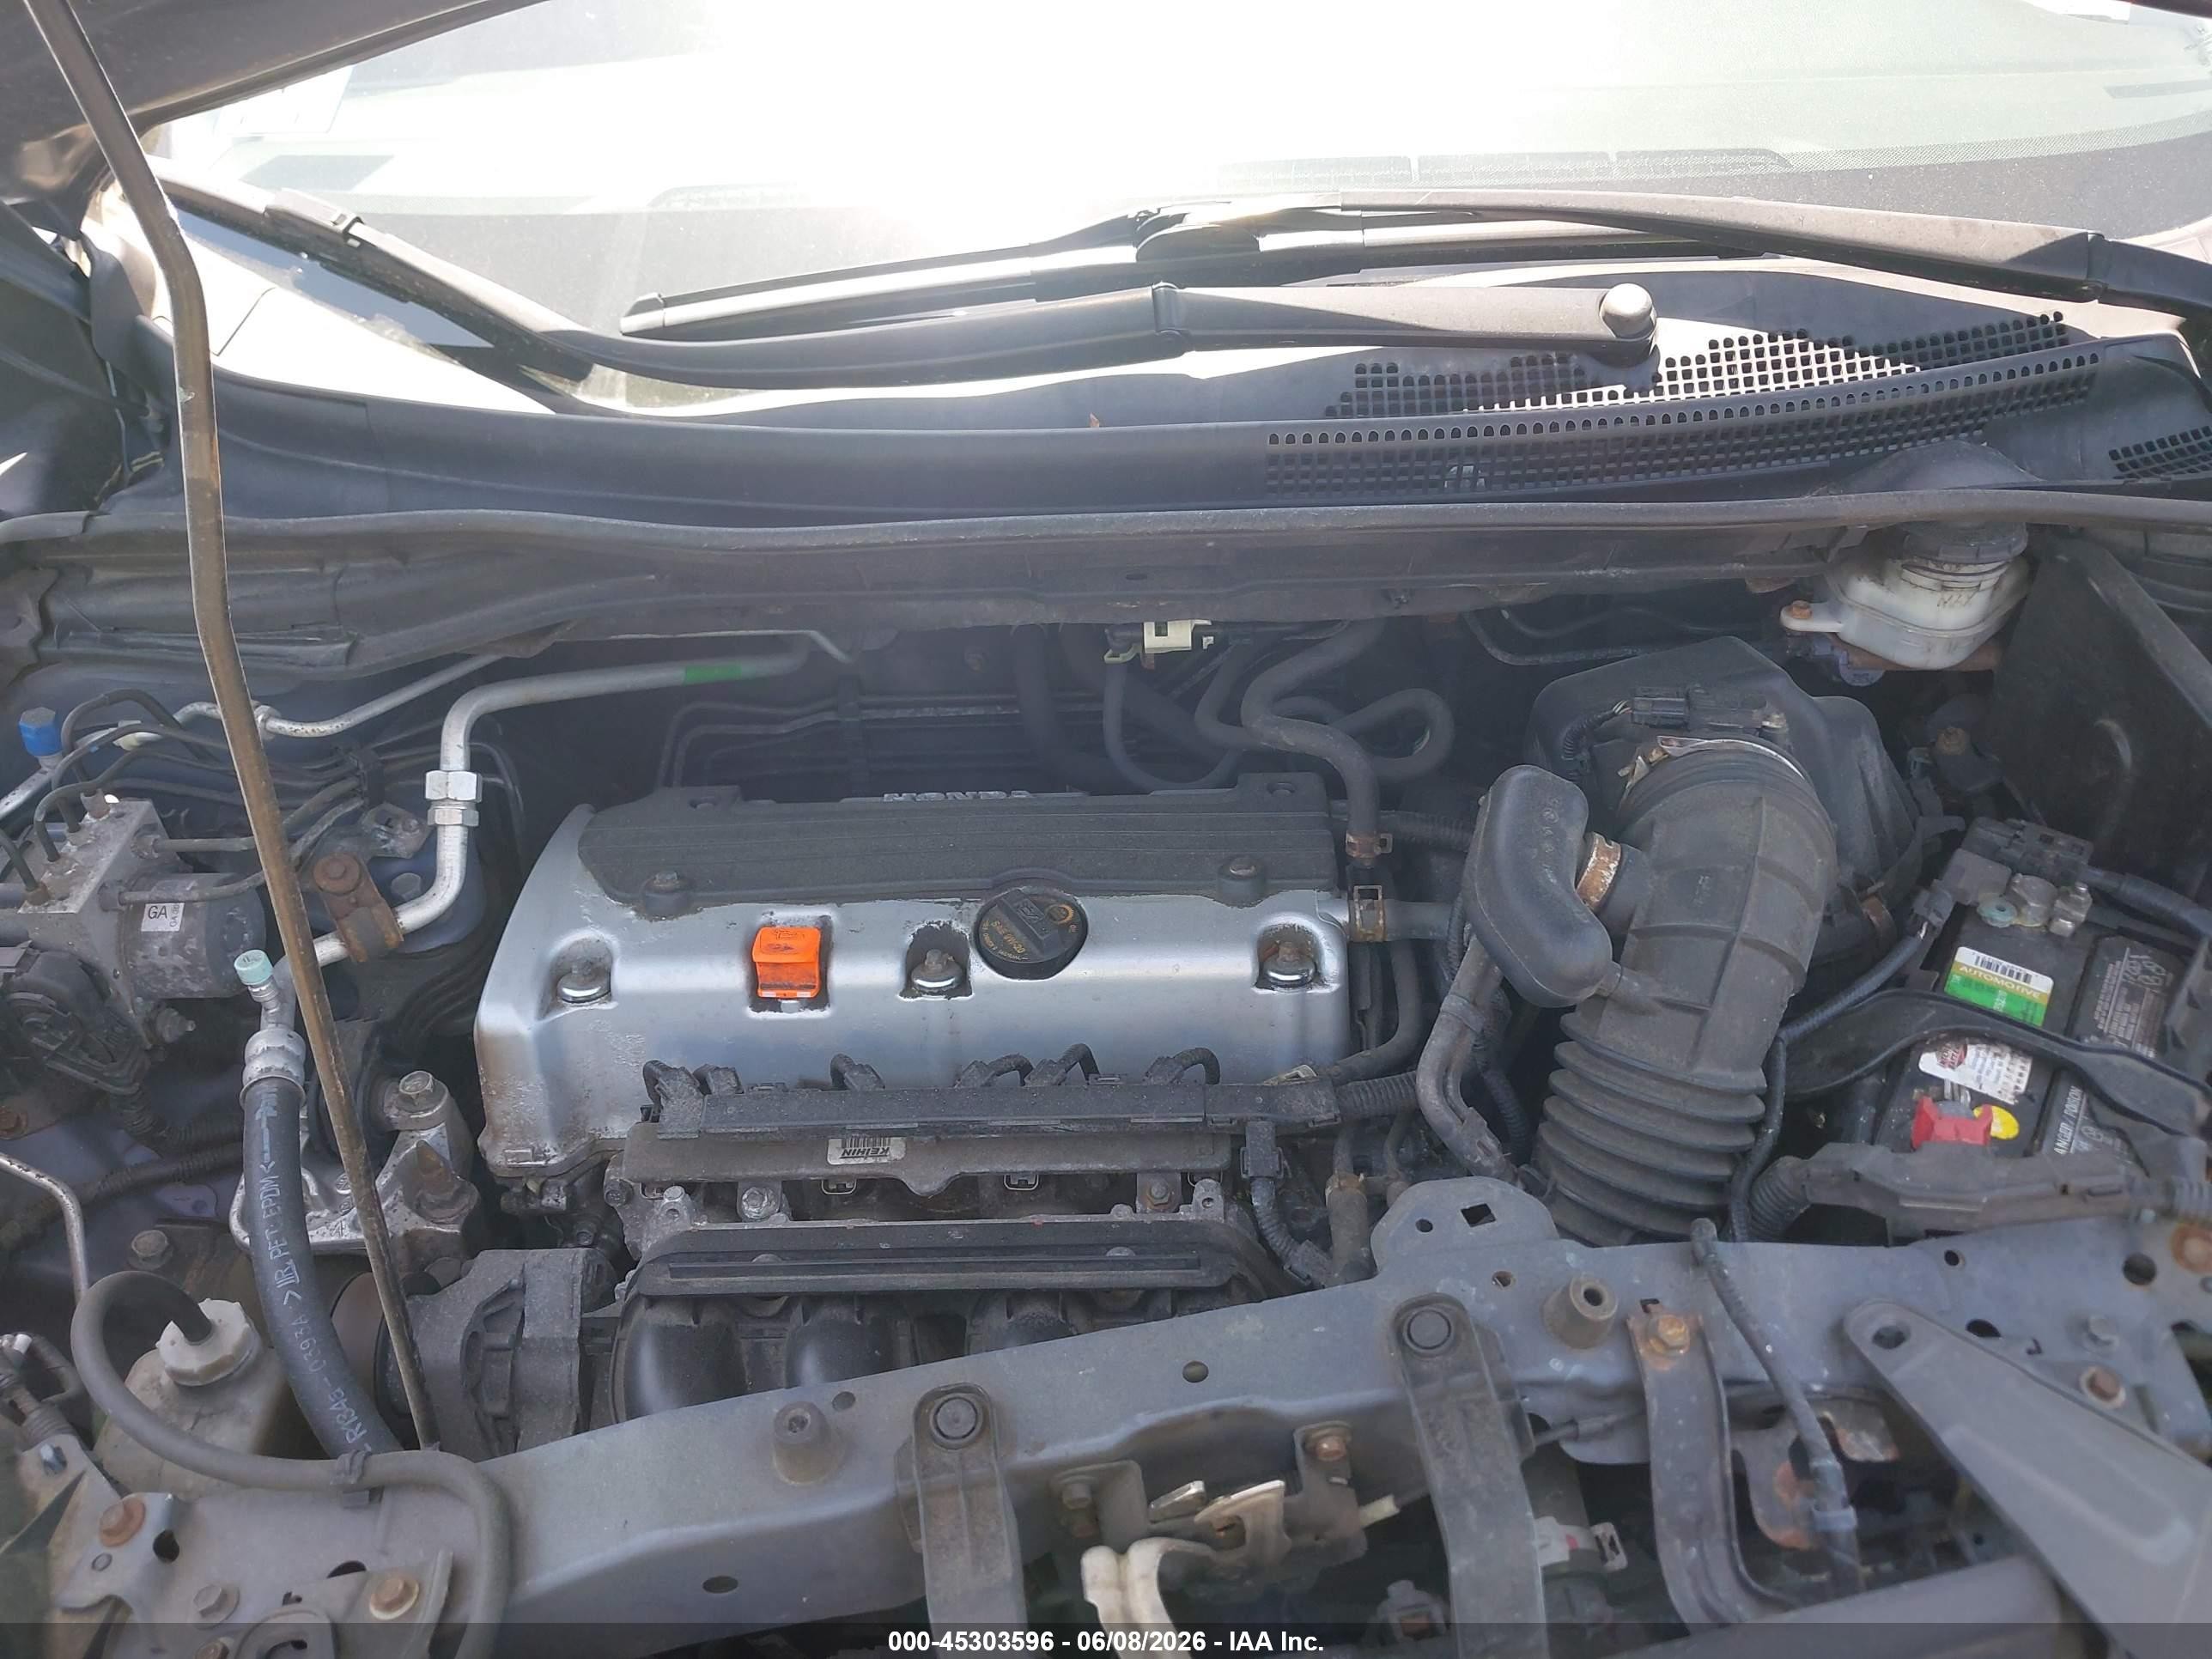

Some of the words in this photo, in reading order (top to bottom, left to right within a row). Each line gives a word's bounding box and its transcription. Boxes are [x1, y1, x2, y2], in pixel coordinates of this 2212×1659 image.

[148, 905, 167, 920] GA
[1959, 964, 2041, 1000] AUTOMOTIVE
[841, 1146, 890, 1157] KEIHIN
